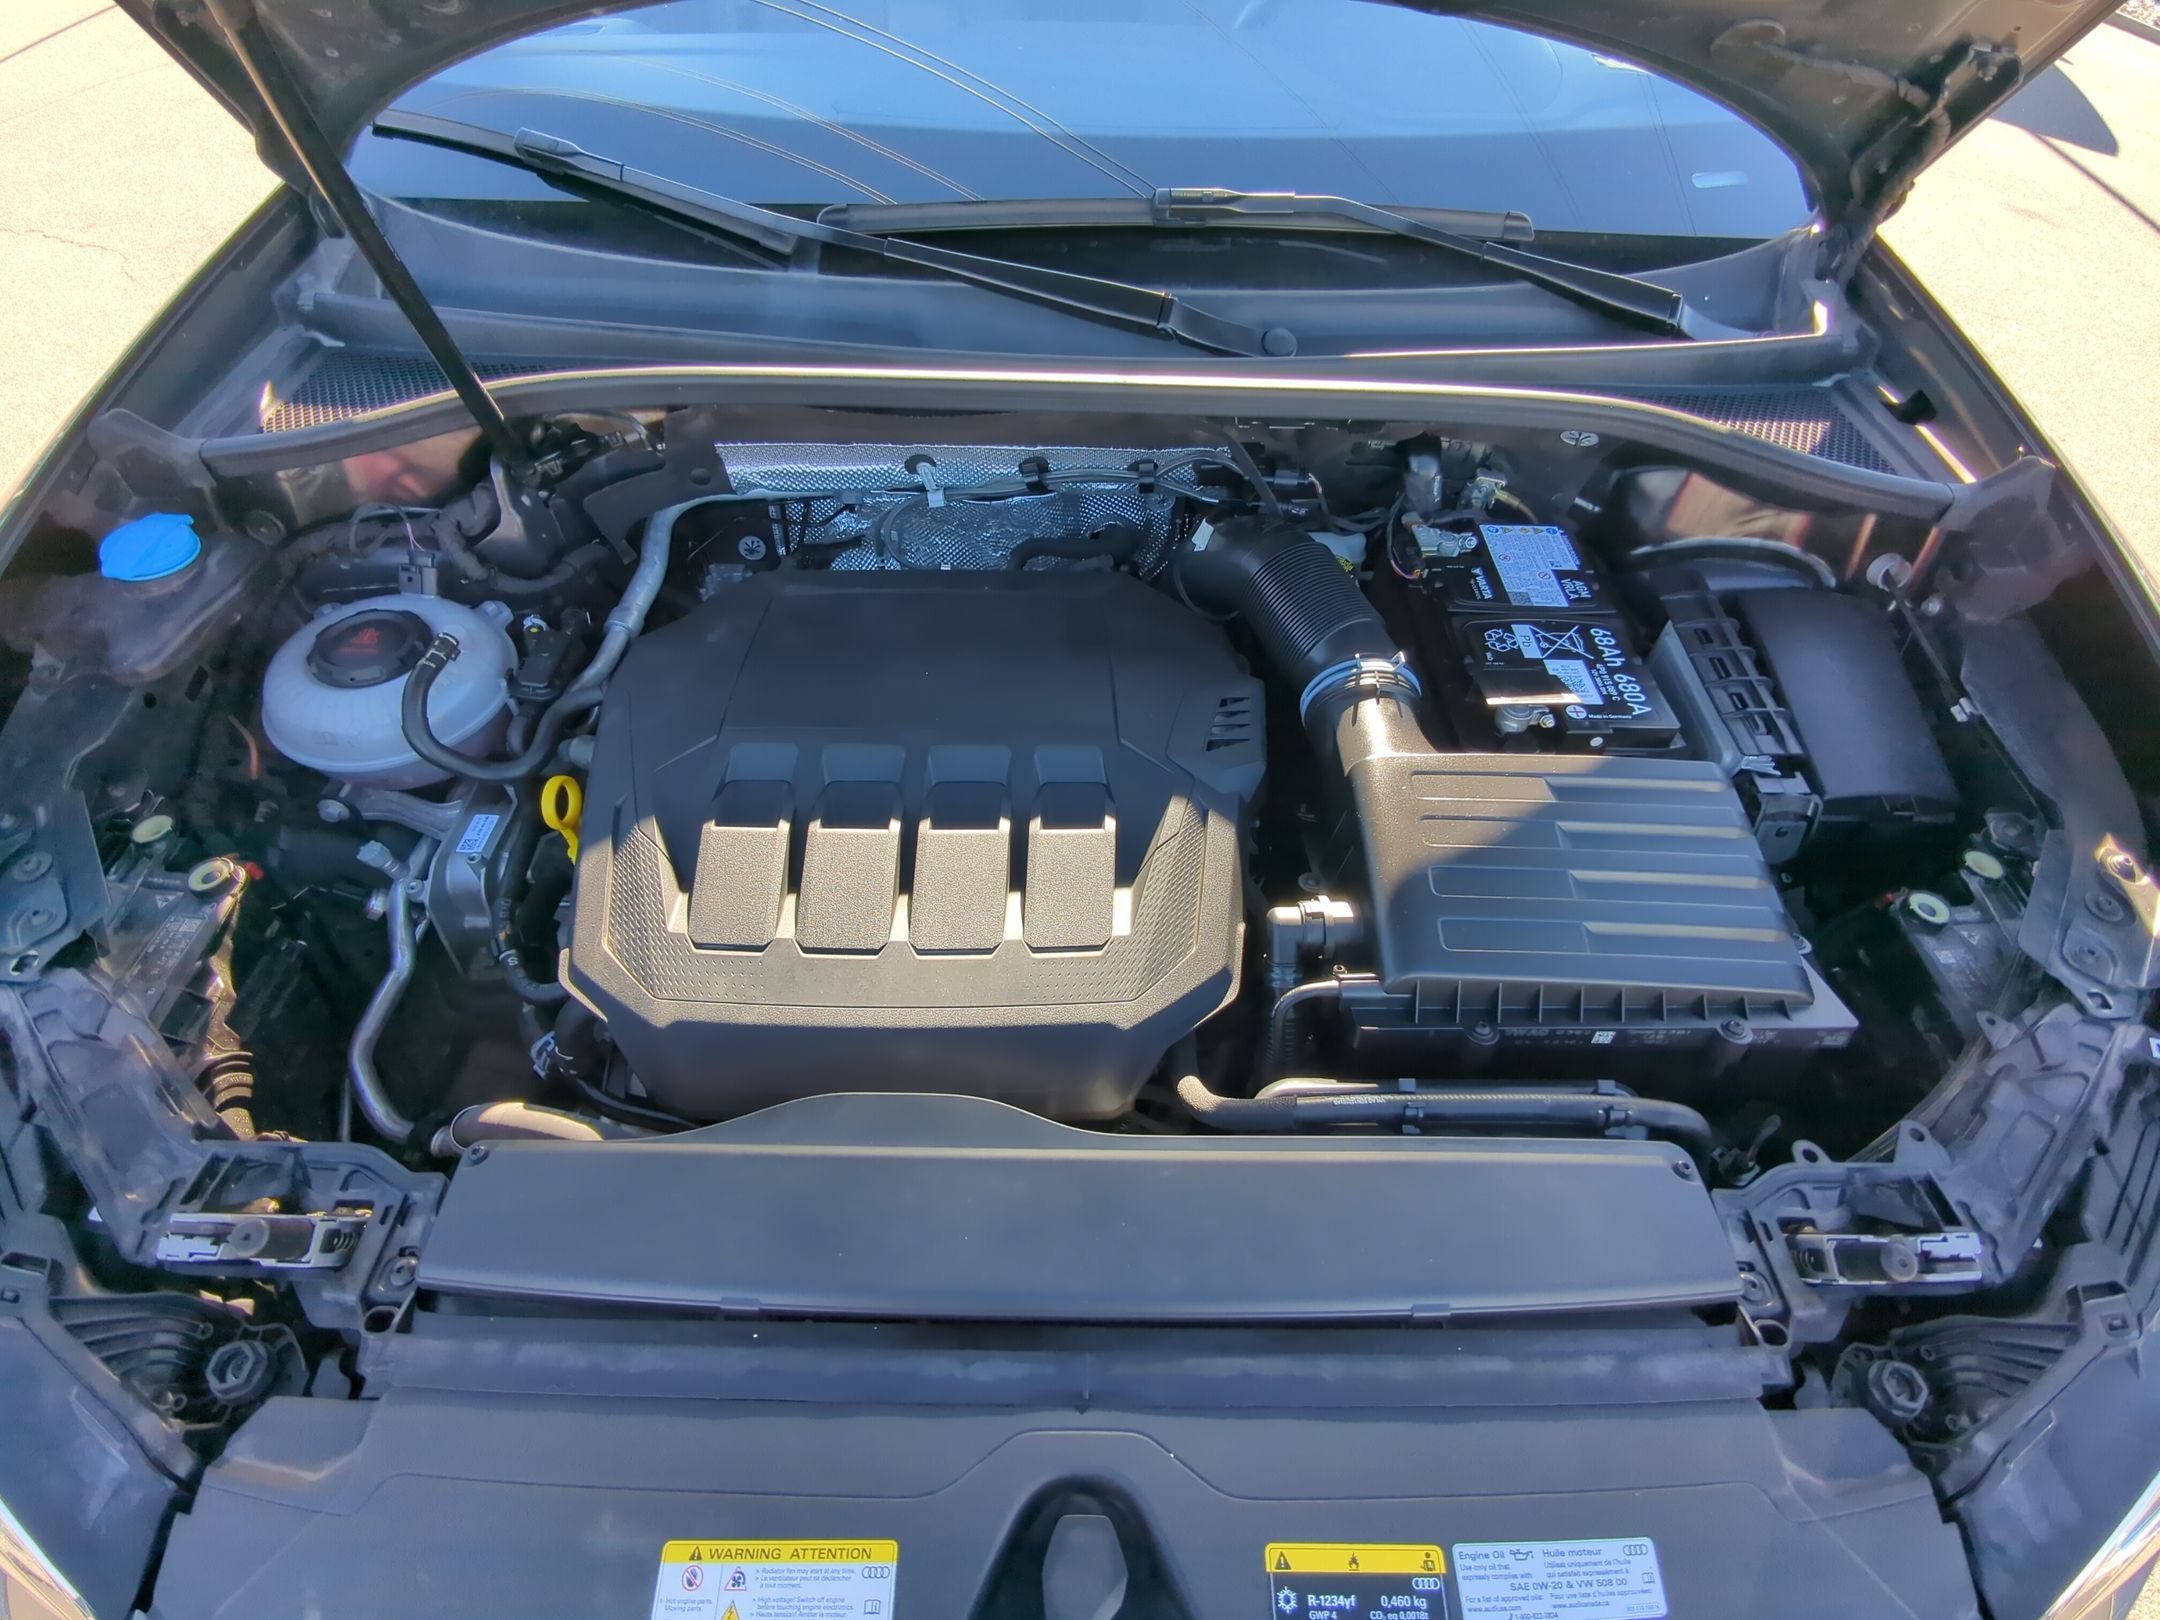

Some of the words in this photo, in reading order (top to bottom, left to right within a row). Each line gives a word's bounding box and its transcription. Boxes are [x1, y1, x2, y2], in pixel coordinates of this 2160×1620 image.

[1475, 575, 1493, 600] VARTA
[1560, 578, 1579, 600] VRLA
[1572, 580, 1592, 598] AGM
[1520, 635, 1532, 647] Pb
[1590, 628, 1626, 666] 68Ah
[1613, 674, 1652, 715] 680A
[709, 1548, 782, 1560] WARNING
[789, 1547, 873, 1560] ATTENTION
[1459, 1551, 1490, 1561] Engine
[1492, 1550, 1505, 1559] Oil
[1542, 1549, 1566, 1557] Huile
[1568, 1549, 1602, 1557] moteur
[1474, 1564, 1487, 1572] only
[1567, 1560, 1603, 1568] uniquement
[1510, 1582, 1530, 1591] SAE
[1532, 1580, 1563, 1590] 0W-20
[1566, 1580, 1574, 1588] &
[1576, 1580, 1594, 1588] VW
[1596, 1579, 1614, 1587] 508
[1616, 1578, 1628, 1586] 00
[1307, 1595, 1355, 1609] R-1234yf
[1380, 1595, 1410, 1608] 0,460
[1413, 1595, 1427, 1609] kg
[1501, 1595, 1530, 1603] approved
[1308, 1611, 1330, 1620] GWP
[1331, 1611, 1337, 1620] 4
